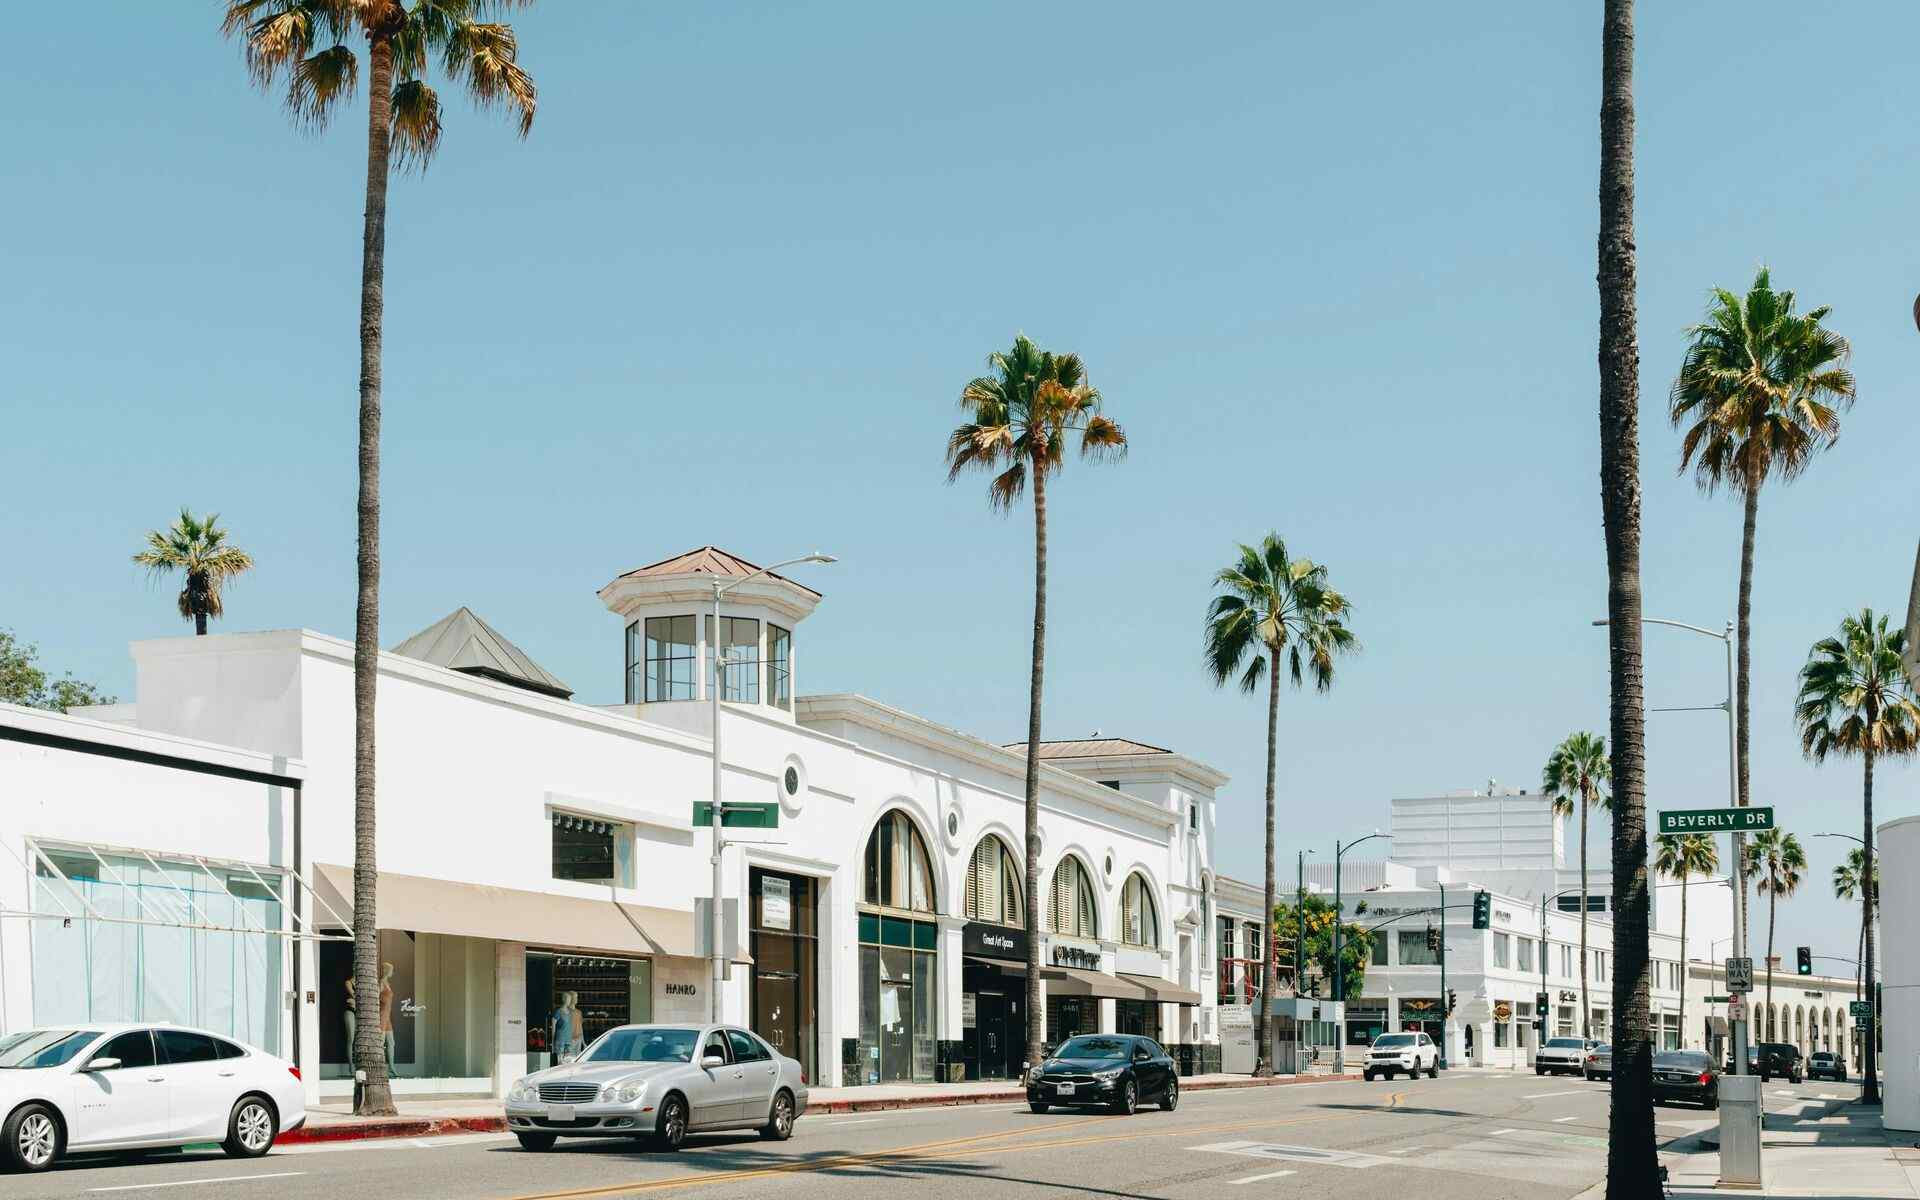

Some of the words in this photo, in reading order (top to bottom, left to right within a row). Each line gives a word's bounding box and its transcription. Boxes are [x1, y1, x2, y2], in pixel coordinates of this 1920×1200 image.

[1667, 814, 1735, 827] BEVERLY
[1746, 813, 1766, 824] DR
[1729, 960, 1749, 968] ONE
[1728, 970, 1749, 978] WAY
[666, 983, 696, 995] HANRO
